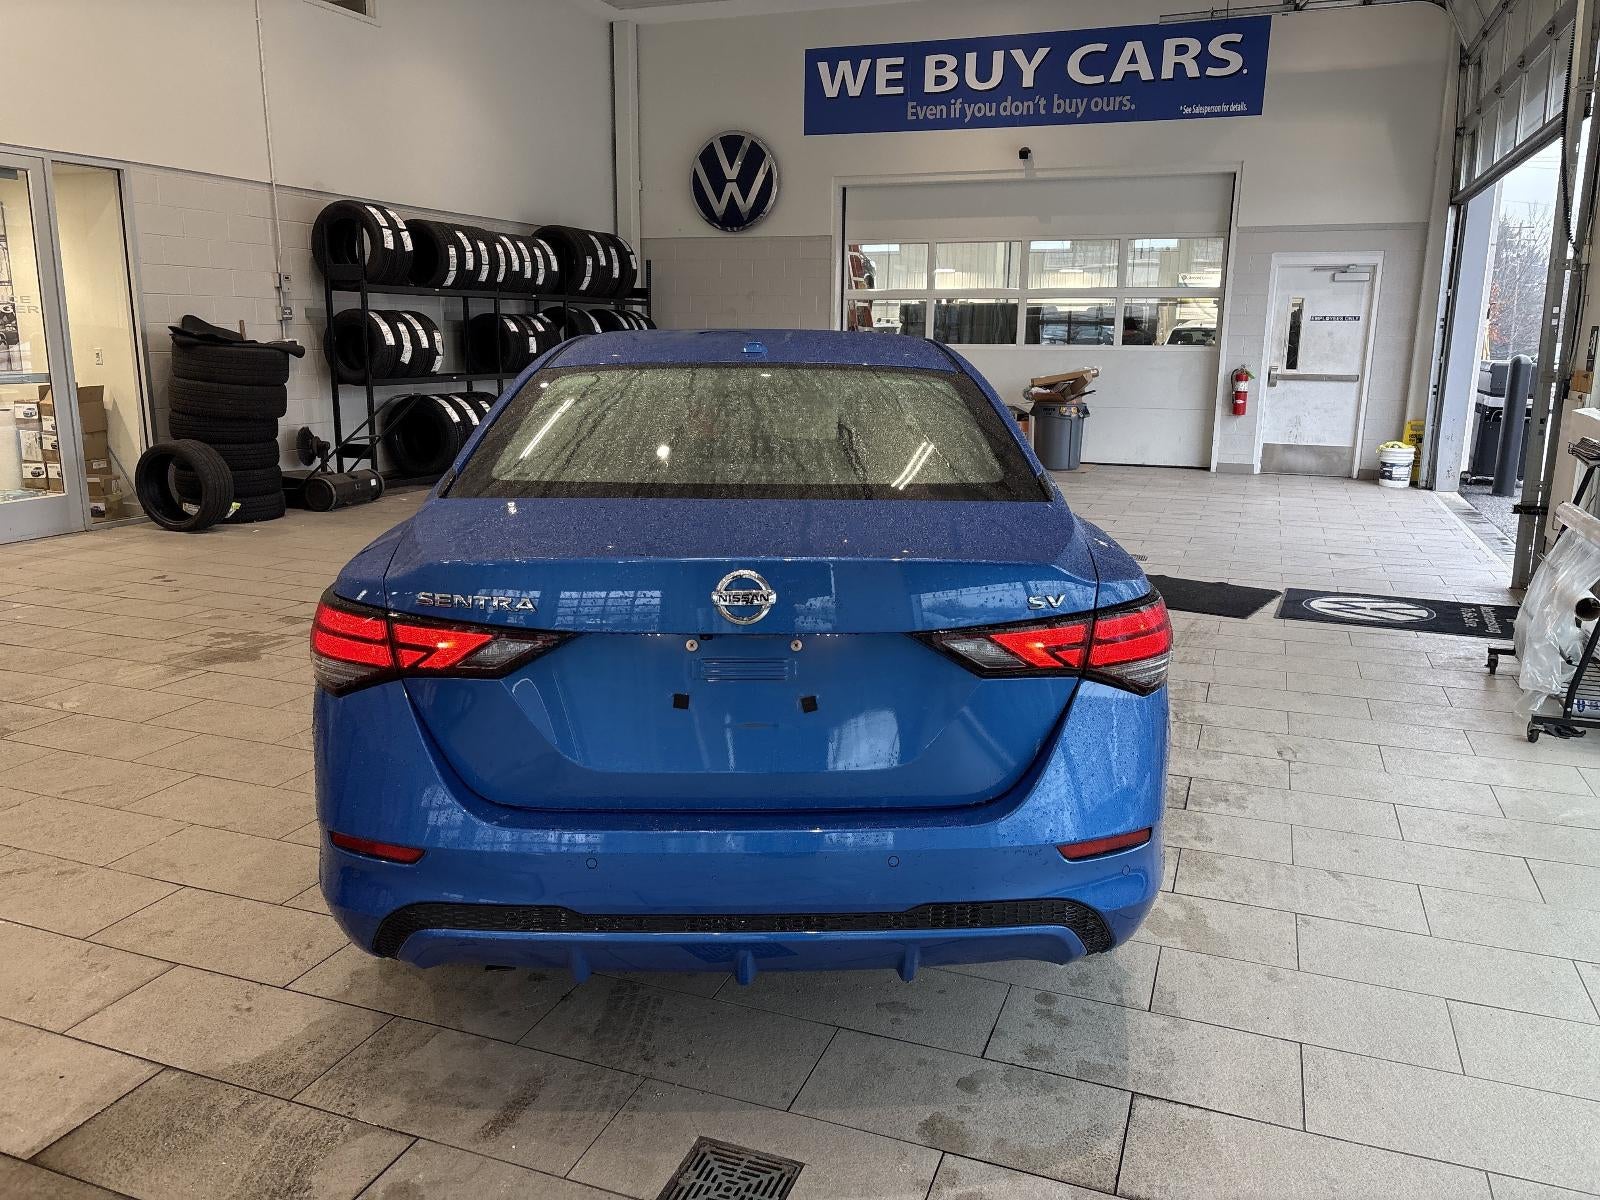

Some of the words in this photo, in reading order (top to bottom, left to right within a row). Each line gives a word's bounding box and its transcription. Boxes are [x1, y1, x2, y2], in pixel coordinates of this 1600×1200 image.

[817, 57, 905, 99] WE
[923, 47, 1051, 94] BUY
[1066, 33, 1249, 86] CARS.
[907, 101, 947, 120] Even
[950, 99, 962, 119] if
[964, 101, 996, 123] you
[1000, 95, 1047, 116] don't
[1052, 94, 1087, 118] buy
[1090, 95, 1136, 112] ours.
[1192, 103, 1221, 115] Salesperson
[1221, 102, 1230, 112] for
[416, 591, 536, 612] SENTRA
[718, 594, 770, 604] NISSAN
[1028, 594, 1066, 609] SV
